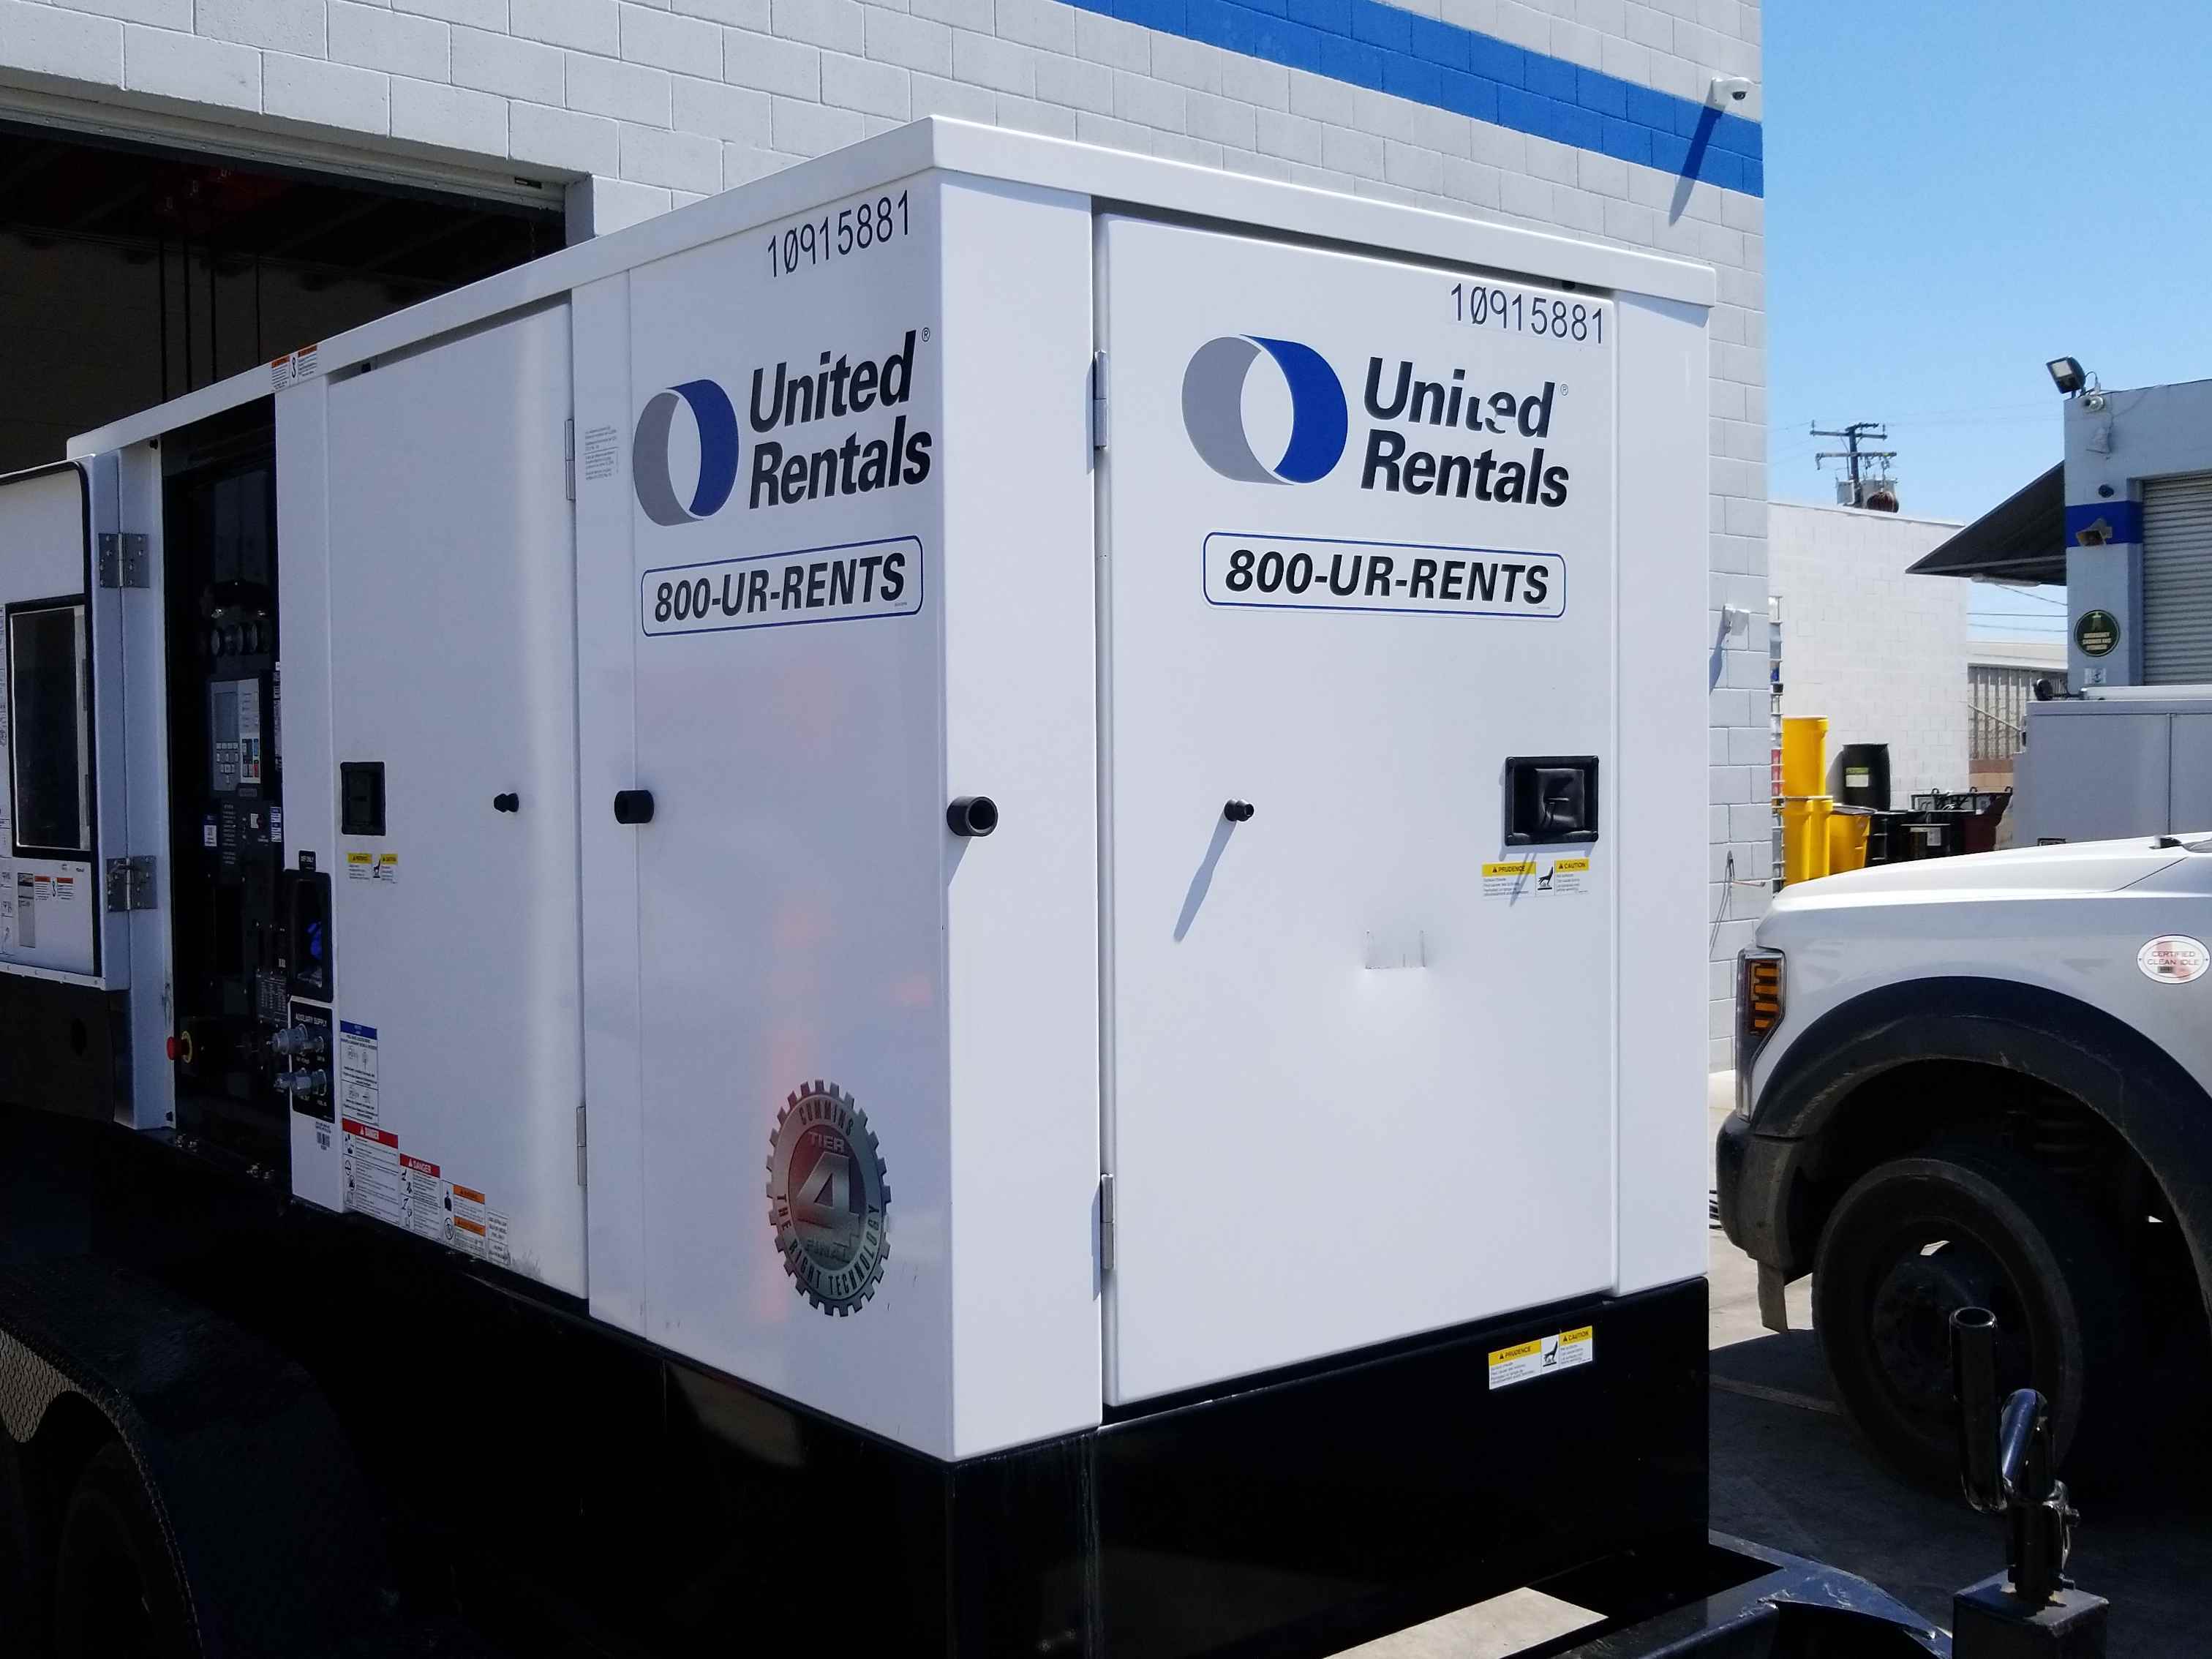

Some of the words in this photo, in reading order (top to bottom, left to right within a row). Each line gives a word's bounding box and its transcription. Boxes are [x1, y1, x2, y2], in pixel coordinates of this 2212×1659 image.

[767, 189, 909, 278] 10915881
[1451, 282, 1603, 345] 10915881
[749, 329, 917, 434] United
[748, 415, 933, 510] Rentals
[1361, 428, 1570, 508] Rentals
[655, 552, 906, 623] 800-UR-RENTS
[1224, 549, 1549, 605] 800-UR-RENTS
[799, 1099, 854, 1135] CUMMINS
[413, 1160, 432, 1174] DANGER
[796, 1151, 859, 1247] 4
[776, 1194, 792, 1232] THE
[789, 1238, 821, 1290] RIGHT
[829, 1204, 880, 1296] TECHNOLOGY
